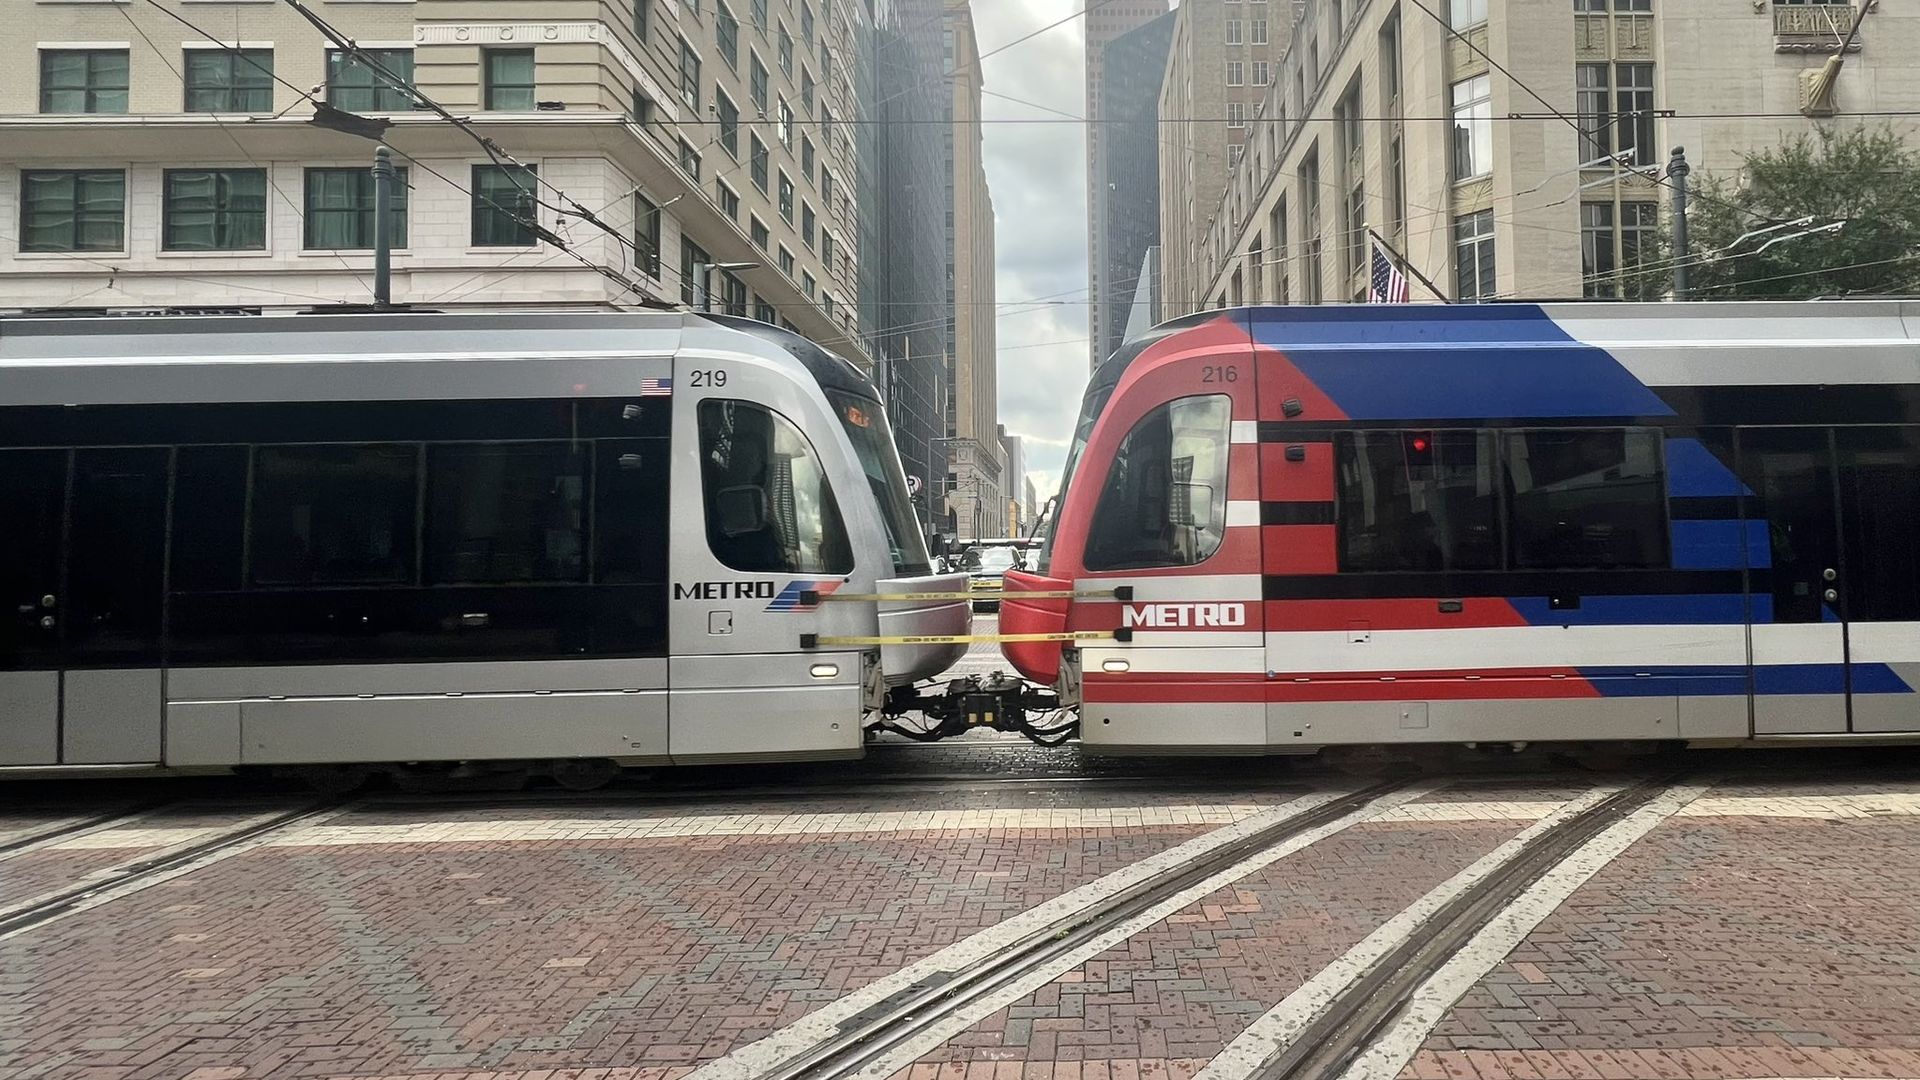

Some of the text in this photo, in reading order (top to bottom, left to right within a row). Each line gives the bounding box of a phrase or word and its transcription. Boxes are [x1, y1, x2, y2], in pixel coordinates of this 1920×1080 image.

[691, 370, 726, 387] 219
[1202, 366, 1237, 382] 216
[674, 581, 774, 600] METRO
[1122, 603, 1245, 627] METRO
